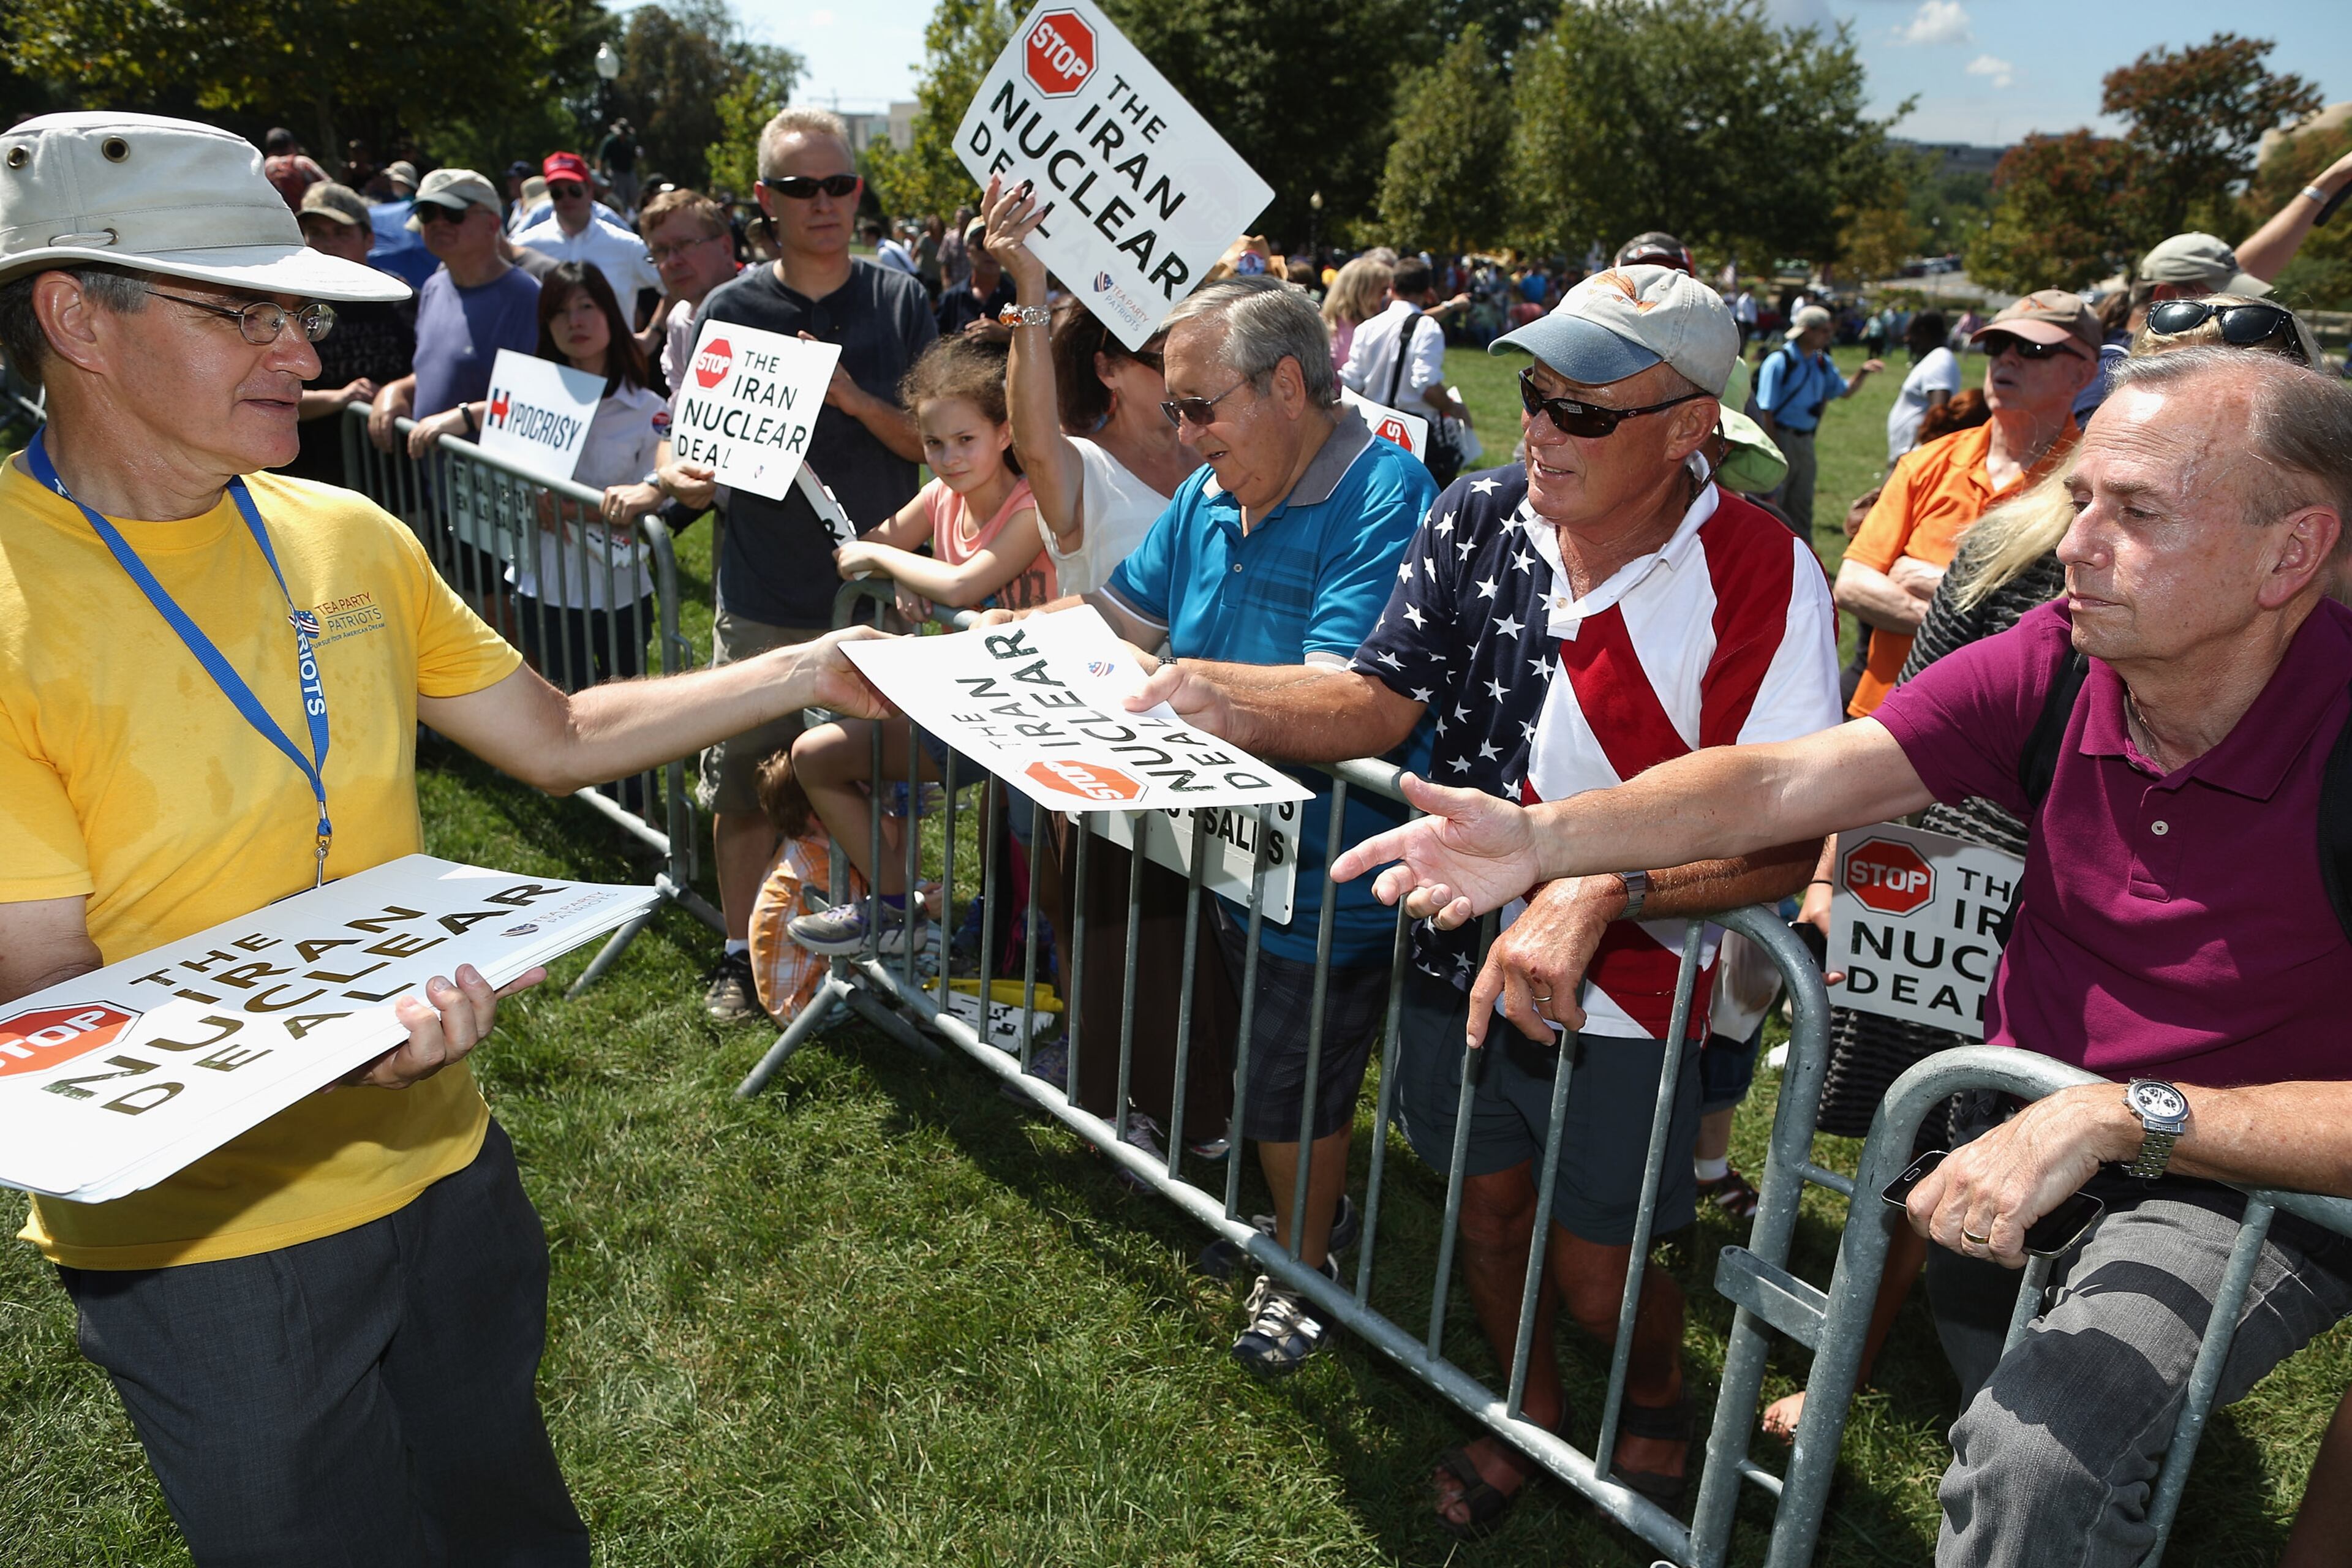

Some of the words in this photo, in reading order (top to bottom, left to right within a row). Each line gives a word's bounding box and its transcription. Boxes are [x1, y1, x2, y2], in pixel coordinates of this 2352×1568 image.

[1031, 21, 1088, 80] STOP
[1107, 74, 1167, 145] THE
[1075, 104, 1186, 221] IRAN
[989, 79, 1189, 301] NUCLEAR
[1104, 294, 1140, 332] PATRIOTS
[1112, 285, 1127, 302] TEA
[1126, 299, 1149, 323] PARTY
[697, 351, 730, 375] STOP
[745, 350, 780, 374] THE
[733, 374, 798, 410] IRAN
[682, 398, 807, 454] NUCLEAR
[677, 434, 731, 469] DEAL
[314, 600, 341, 616] TEA
[338, 592, 372, 611] PARTY
[327, 608, 382, 633] PATRIOTS
[295, 614, 326, 716] TRIOTS
[951, 712, 1022, 750] THE
[955, 677, 1082, 747] IRAN
[985, 628, 1217, 793] NUCLEAR
[1137, 717, 1273, 790] DEAL
[1042, 760, 1125, 801] STOP
[1850, 860, 1928, 894] STOP
[1956, 866, 2011, 903] TH
[530, 910, 559, 922] TEA
[559, 891, 604, 910] PARTY
[547, 892, 619, 924] PATRIOTS
[1954, 898, 2005, 937] IR
[127, 932, 284, 987] THE
[172, 905, 428, 1005] IRAN
[1850, 920, 2002, 984] NUC
[40, 883, 571, 1101] NUCLEAR
[99, 981, 417, 1116] DEAL
